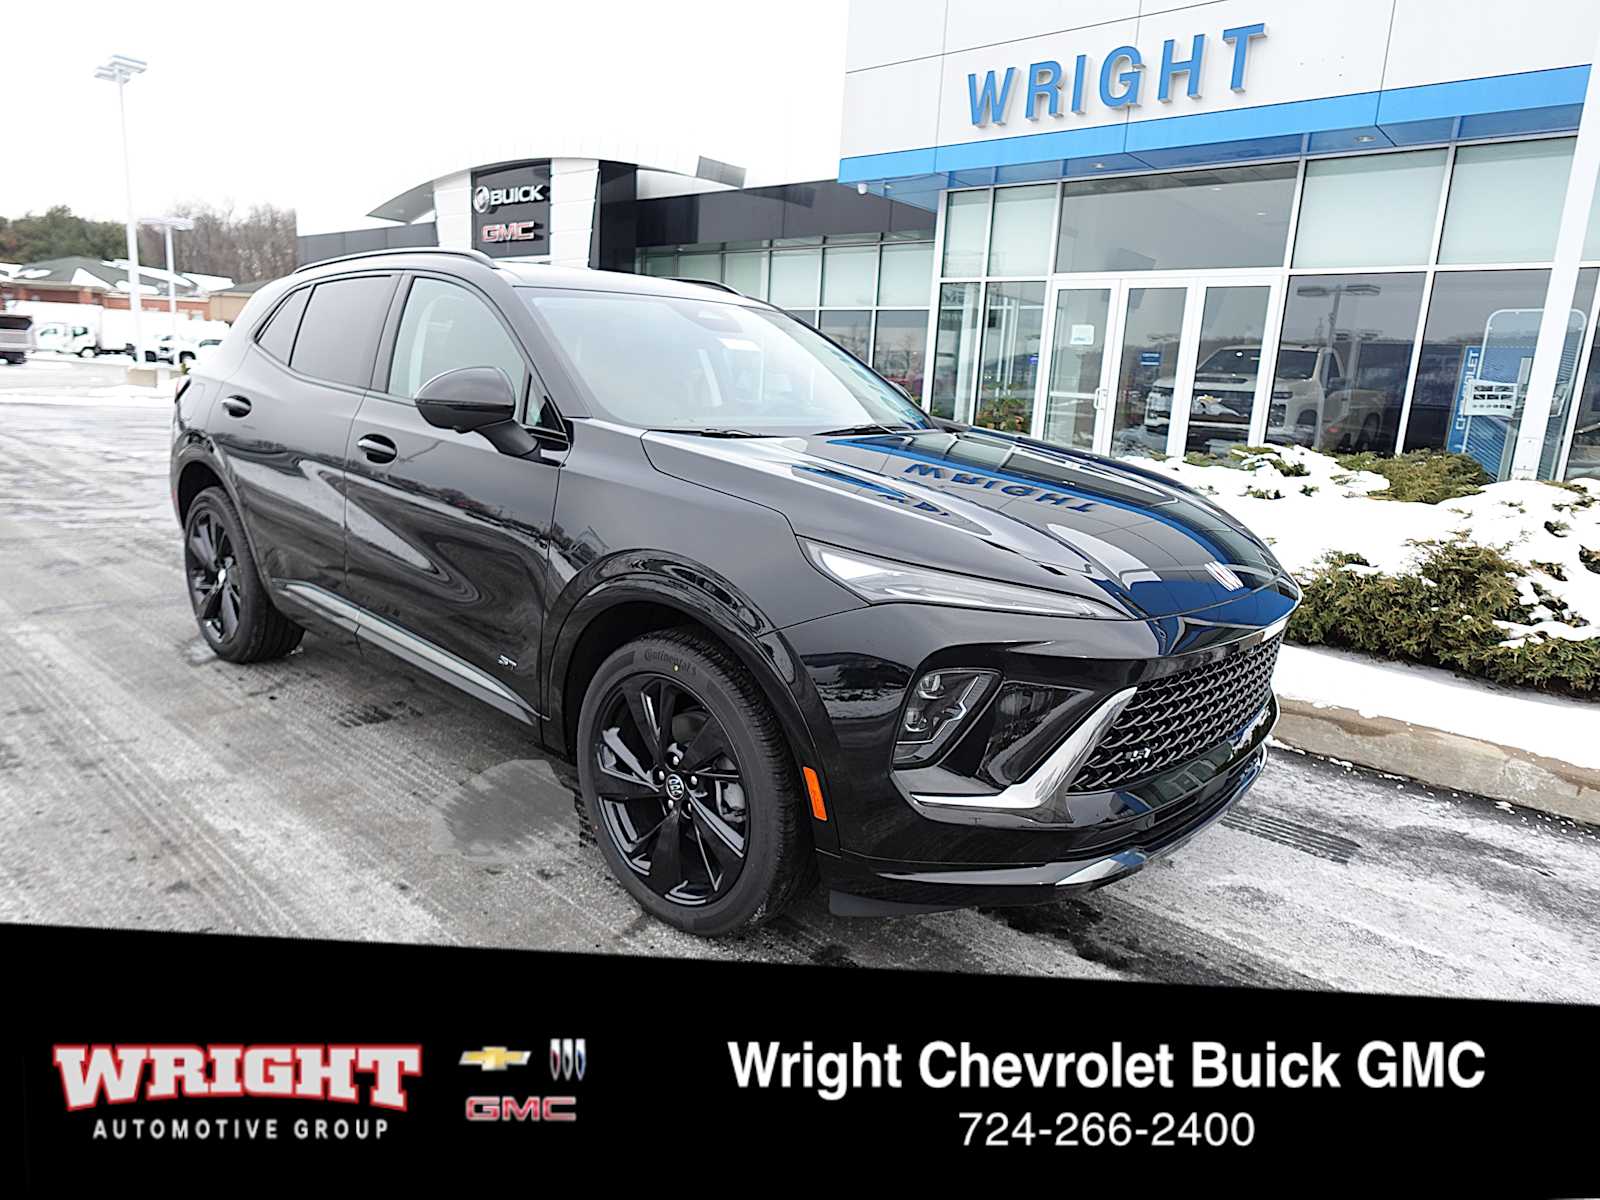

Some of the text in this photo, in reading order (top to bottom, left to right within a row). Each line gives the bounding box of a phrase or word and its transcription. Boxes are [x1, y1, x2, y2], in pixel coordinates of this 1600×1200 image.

[967, 22, 1267, 127] WRIGHT
[490, 184, 545, 206] BUICK
[481, 220, 535, 242] GMC
